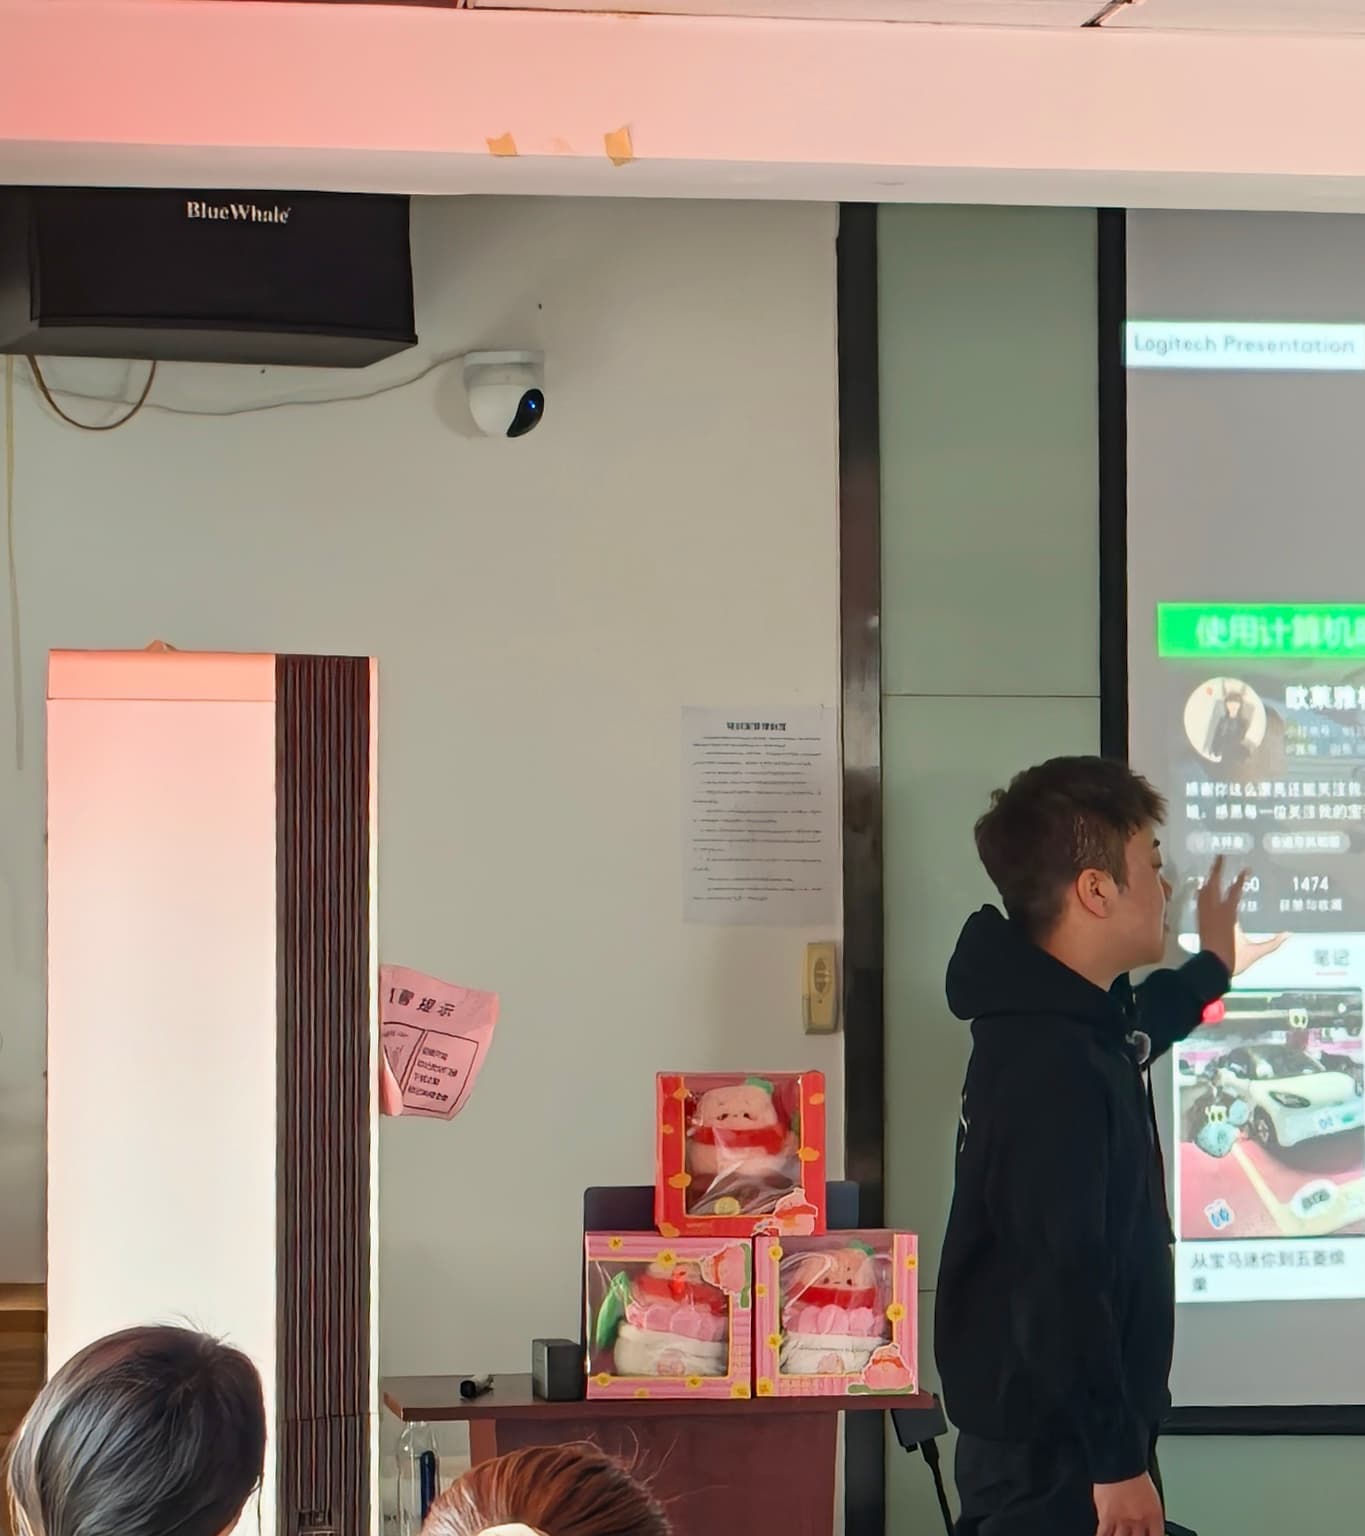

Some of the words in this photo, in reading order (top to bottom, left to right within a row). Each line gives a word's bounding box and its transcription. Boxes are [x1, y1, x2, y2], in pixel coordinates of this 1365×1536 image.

[186, 201, 290, 224] BlueWhale
[1133, 335, 1218, 355] Logitech
[1223, 336, 1356, 354] Presentation
[1291, 876, 1330, 893] 1474
